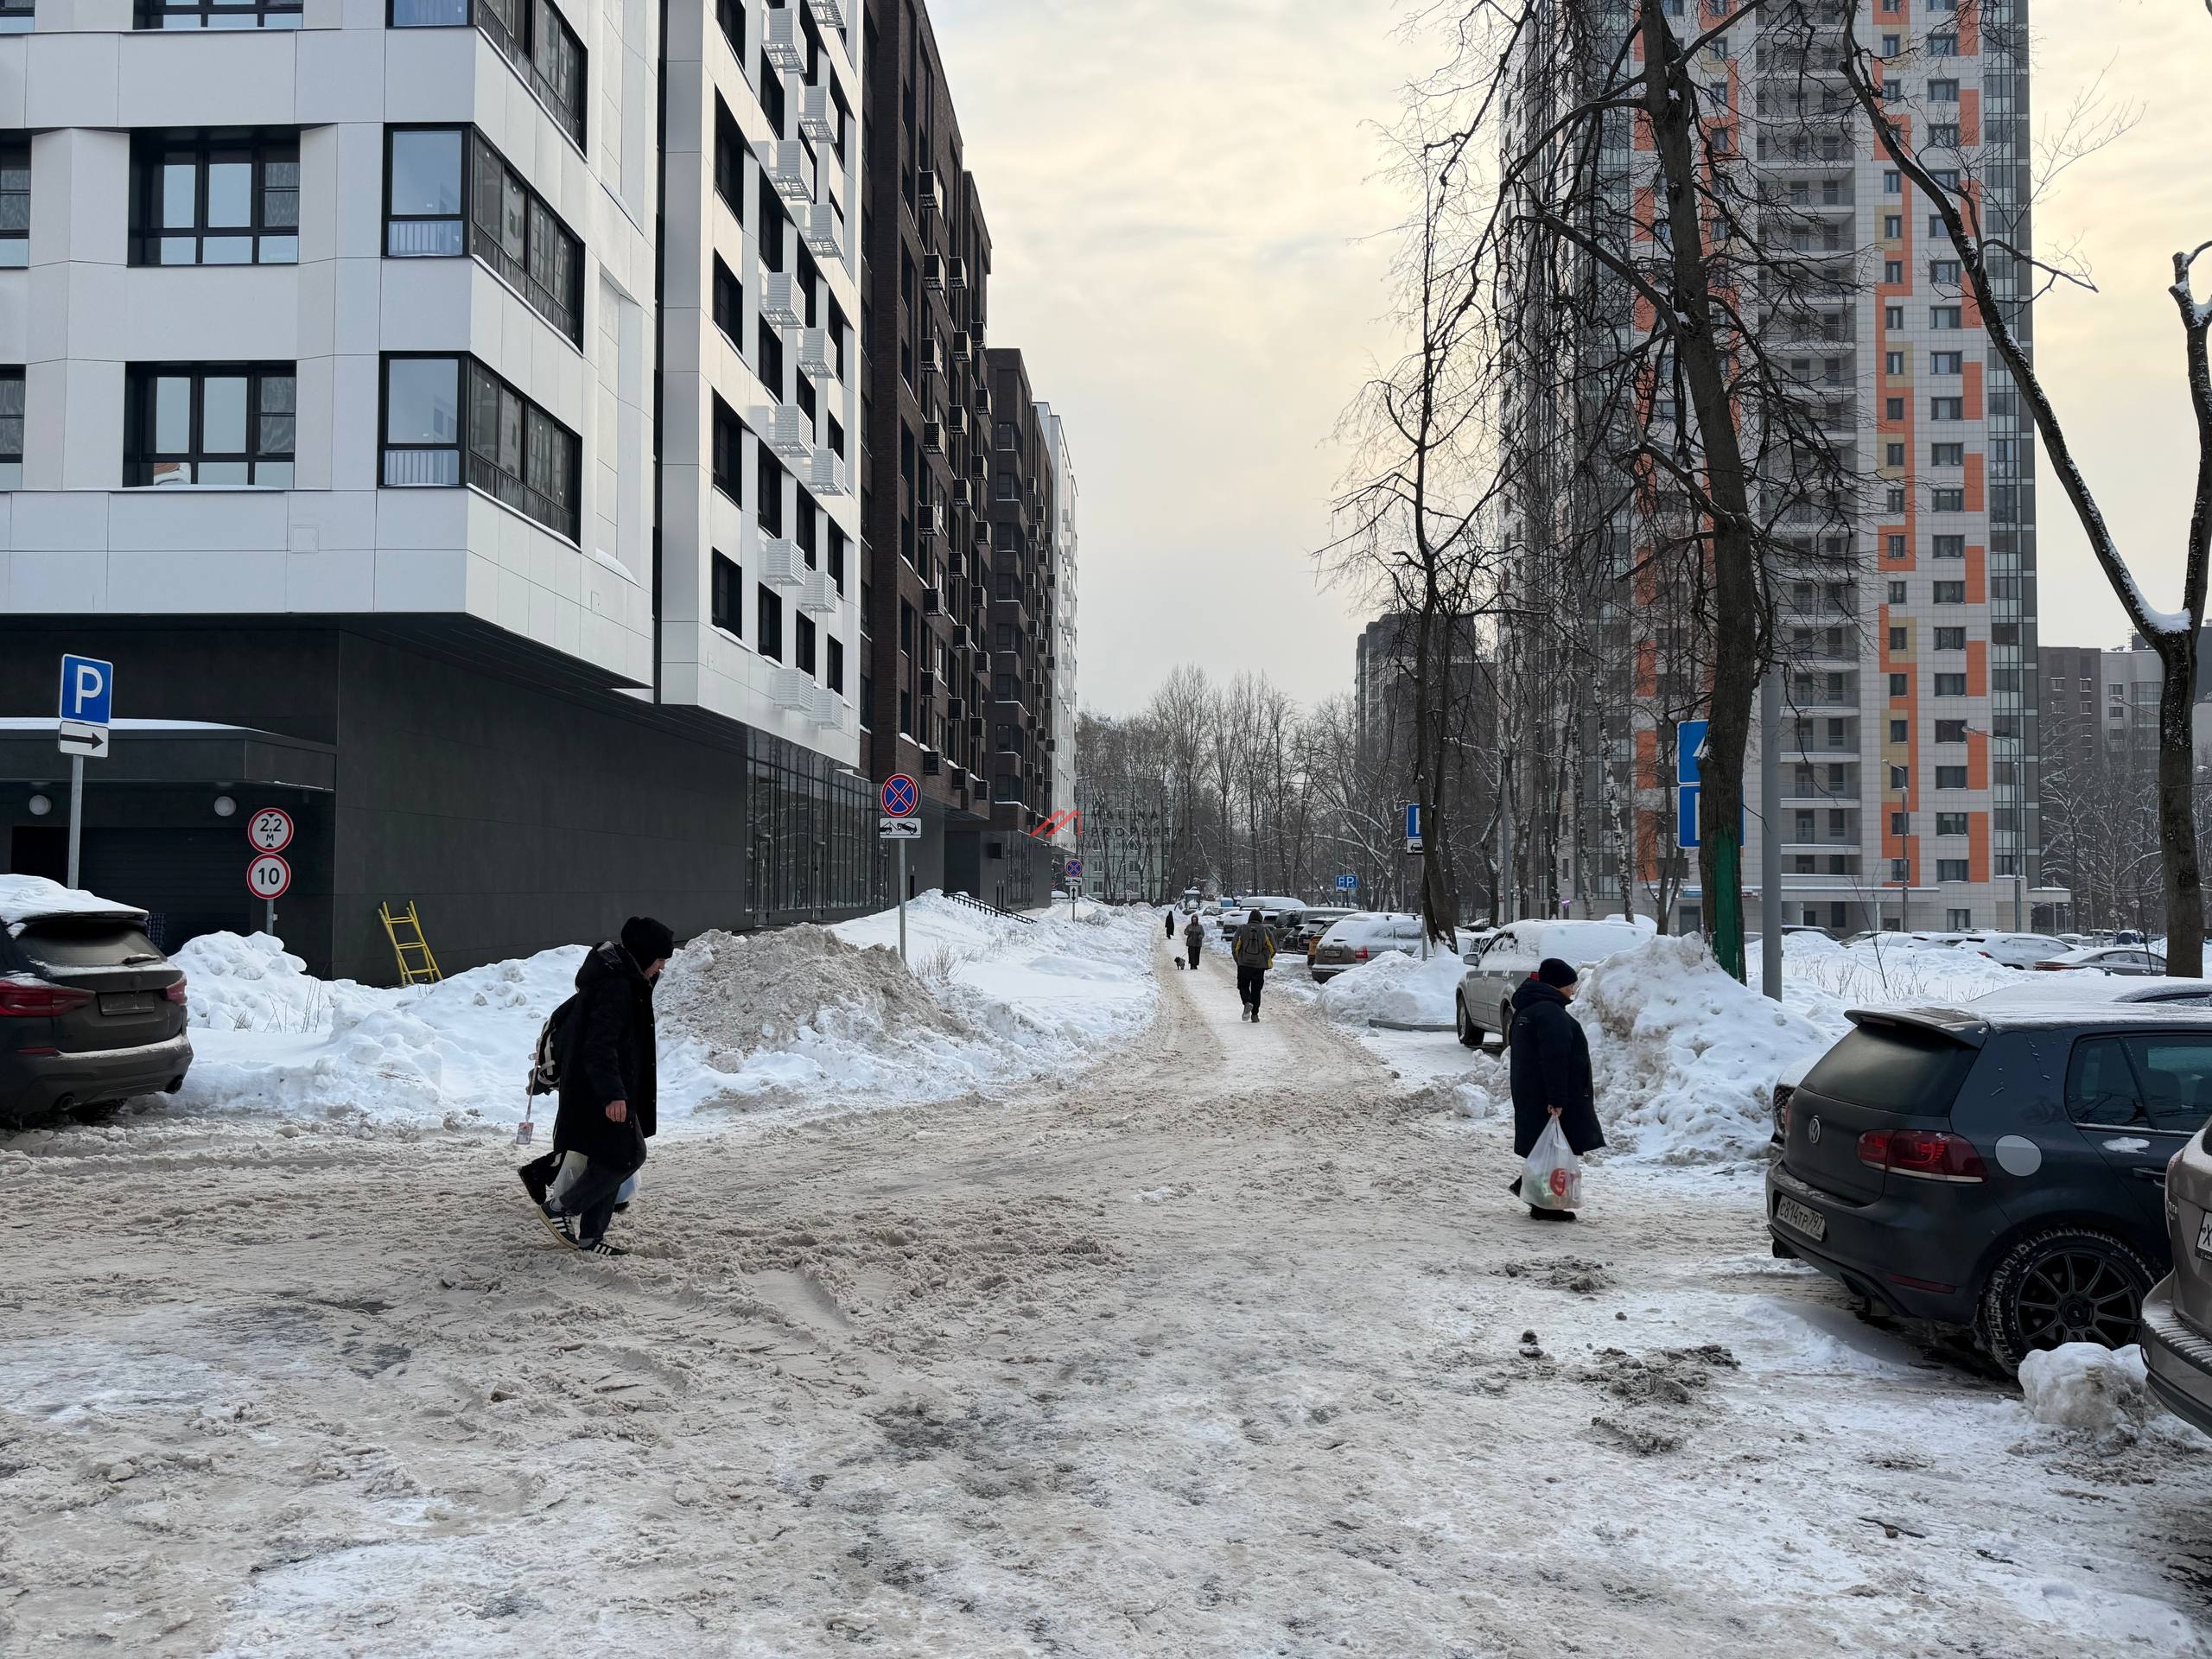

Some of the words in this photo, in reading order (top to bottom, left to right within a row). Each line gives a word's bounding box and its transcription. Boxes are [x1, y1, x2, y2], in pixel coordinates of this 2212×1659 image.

[75, 664, 103, 714] P
[260, 818, 282, 833] 2,2
[258, 868, 280, 885] 10
[1346, 876, 1354, 887] P
